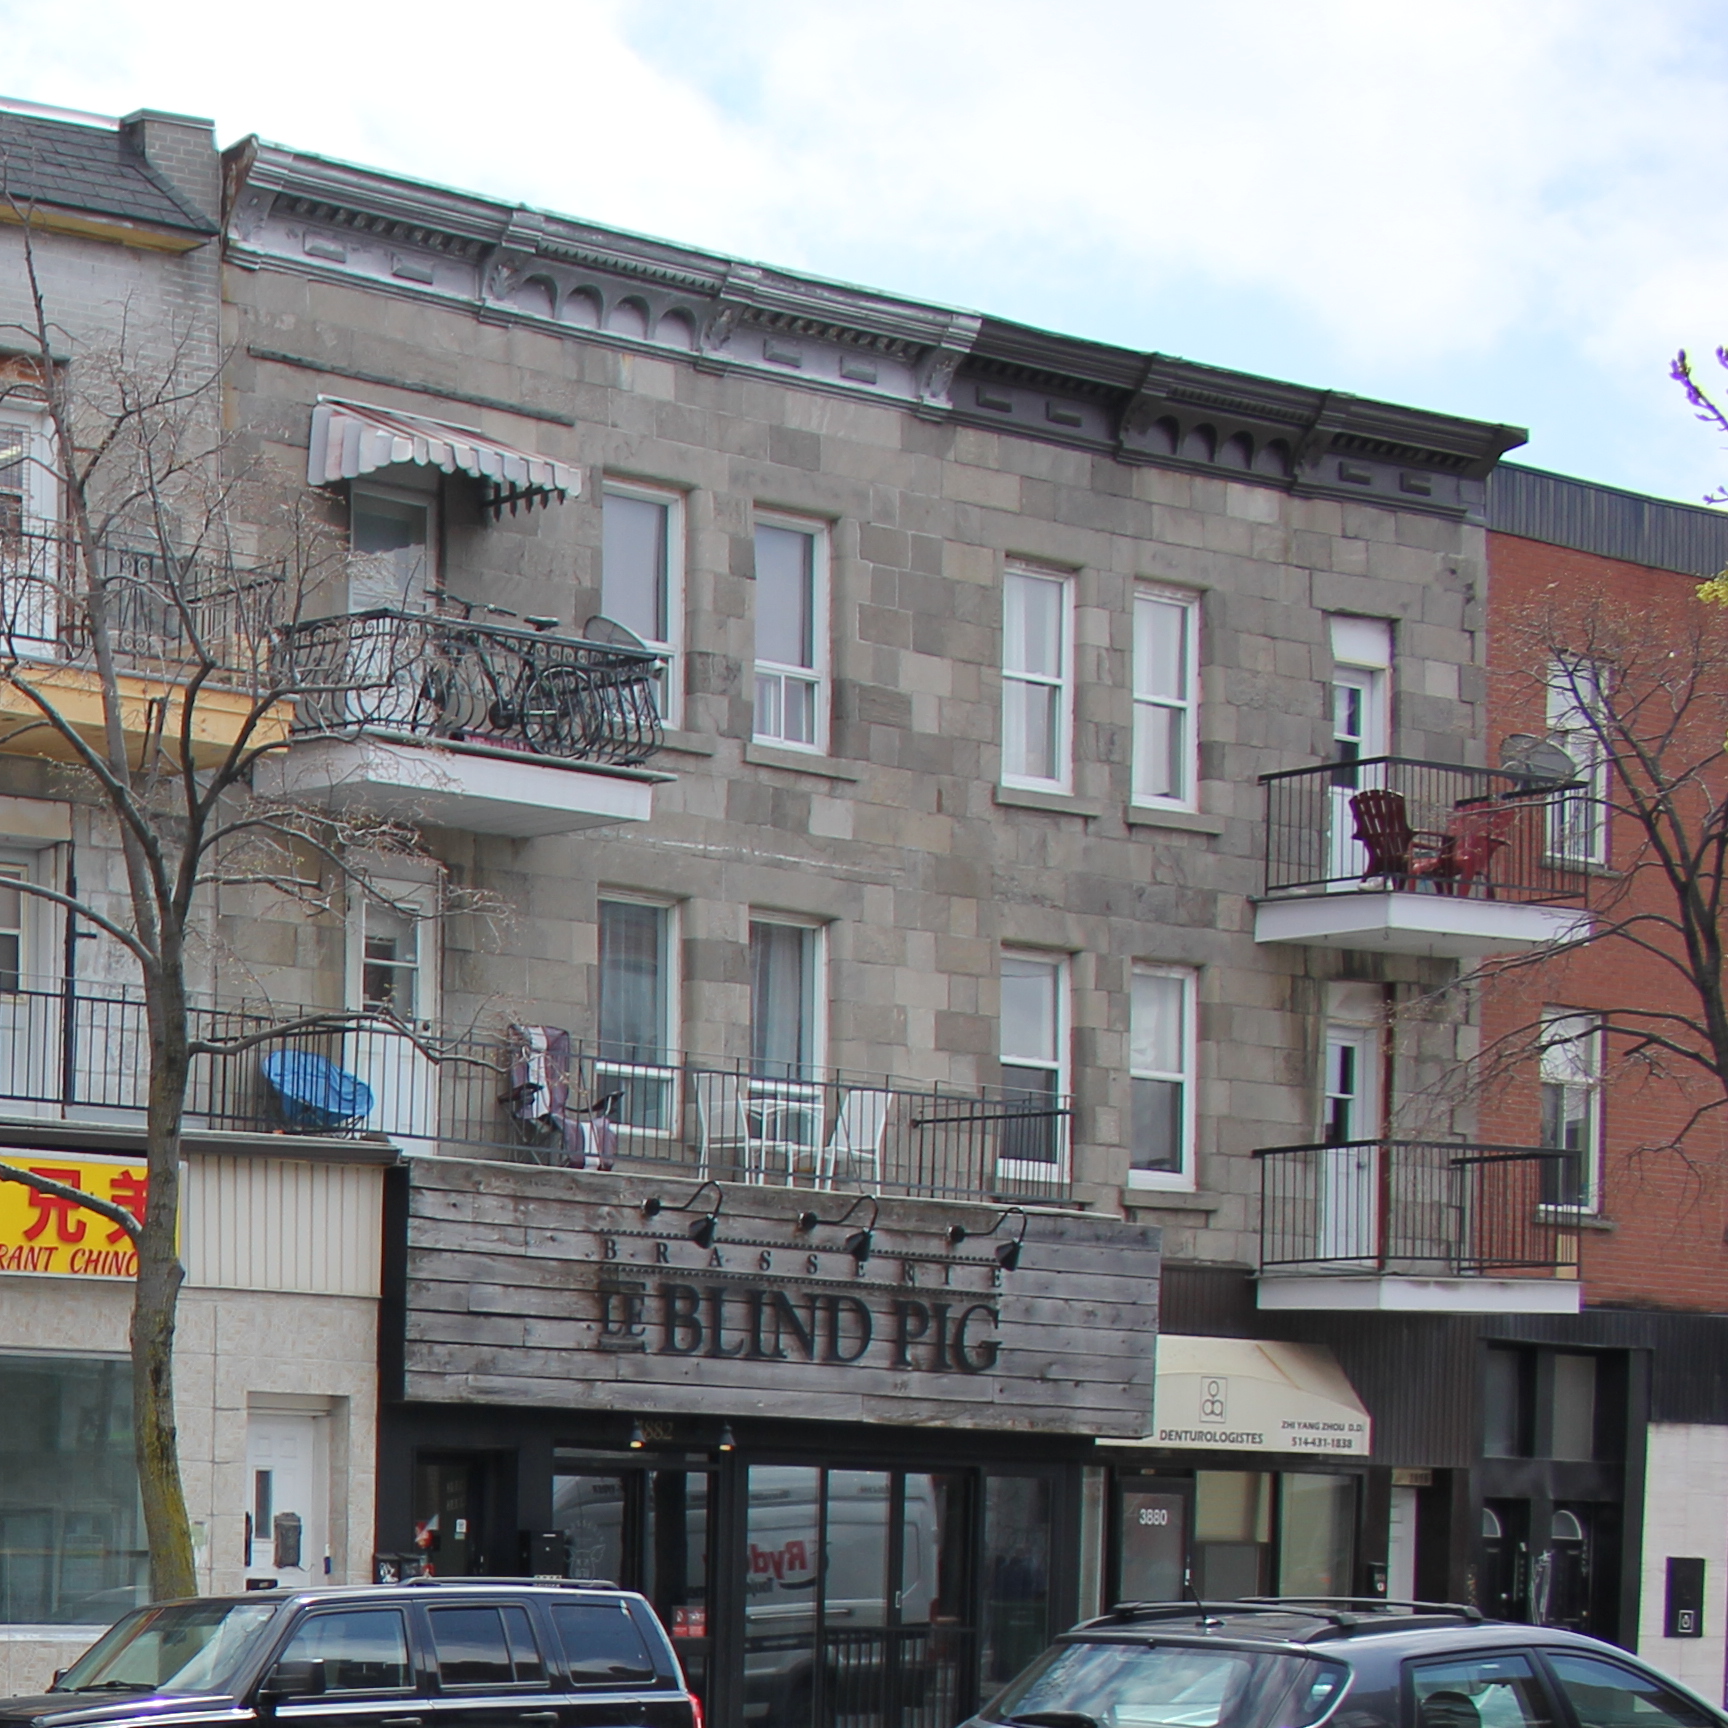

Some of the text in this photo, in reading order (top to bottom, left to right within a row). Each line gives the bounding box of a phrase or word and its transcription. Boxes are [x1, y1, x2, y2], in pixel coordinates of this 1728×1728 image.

[603, 1238, 1002, 1288] BRASSERIE
[600, 1282, 1002, 1373] LE BLIND PIG
[1159, 1429, 1264, 1445] DENTUROLOGISTES
[1139, 1508, 1168, 1526] 3880
